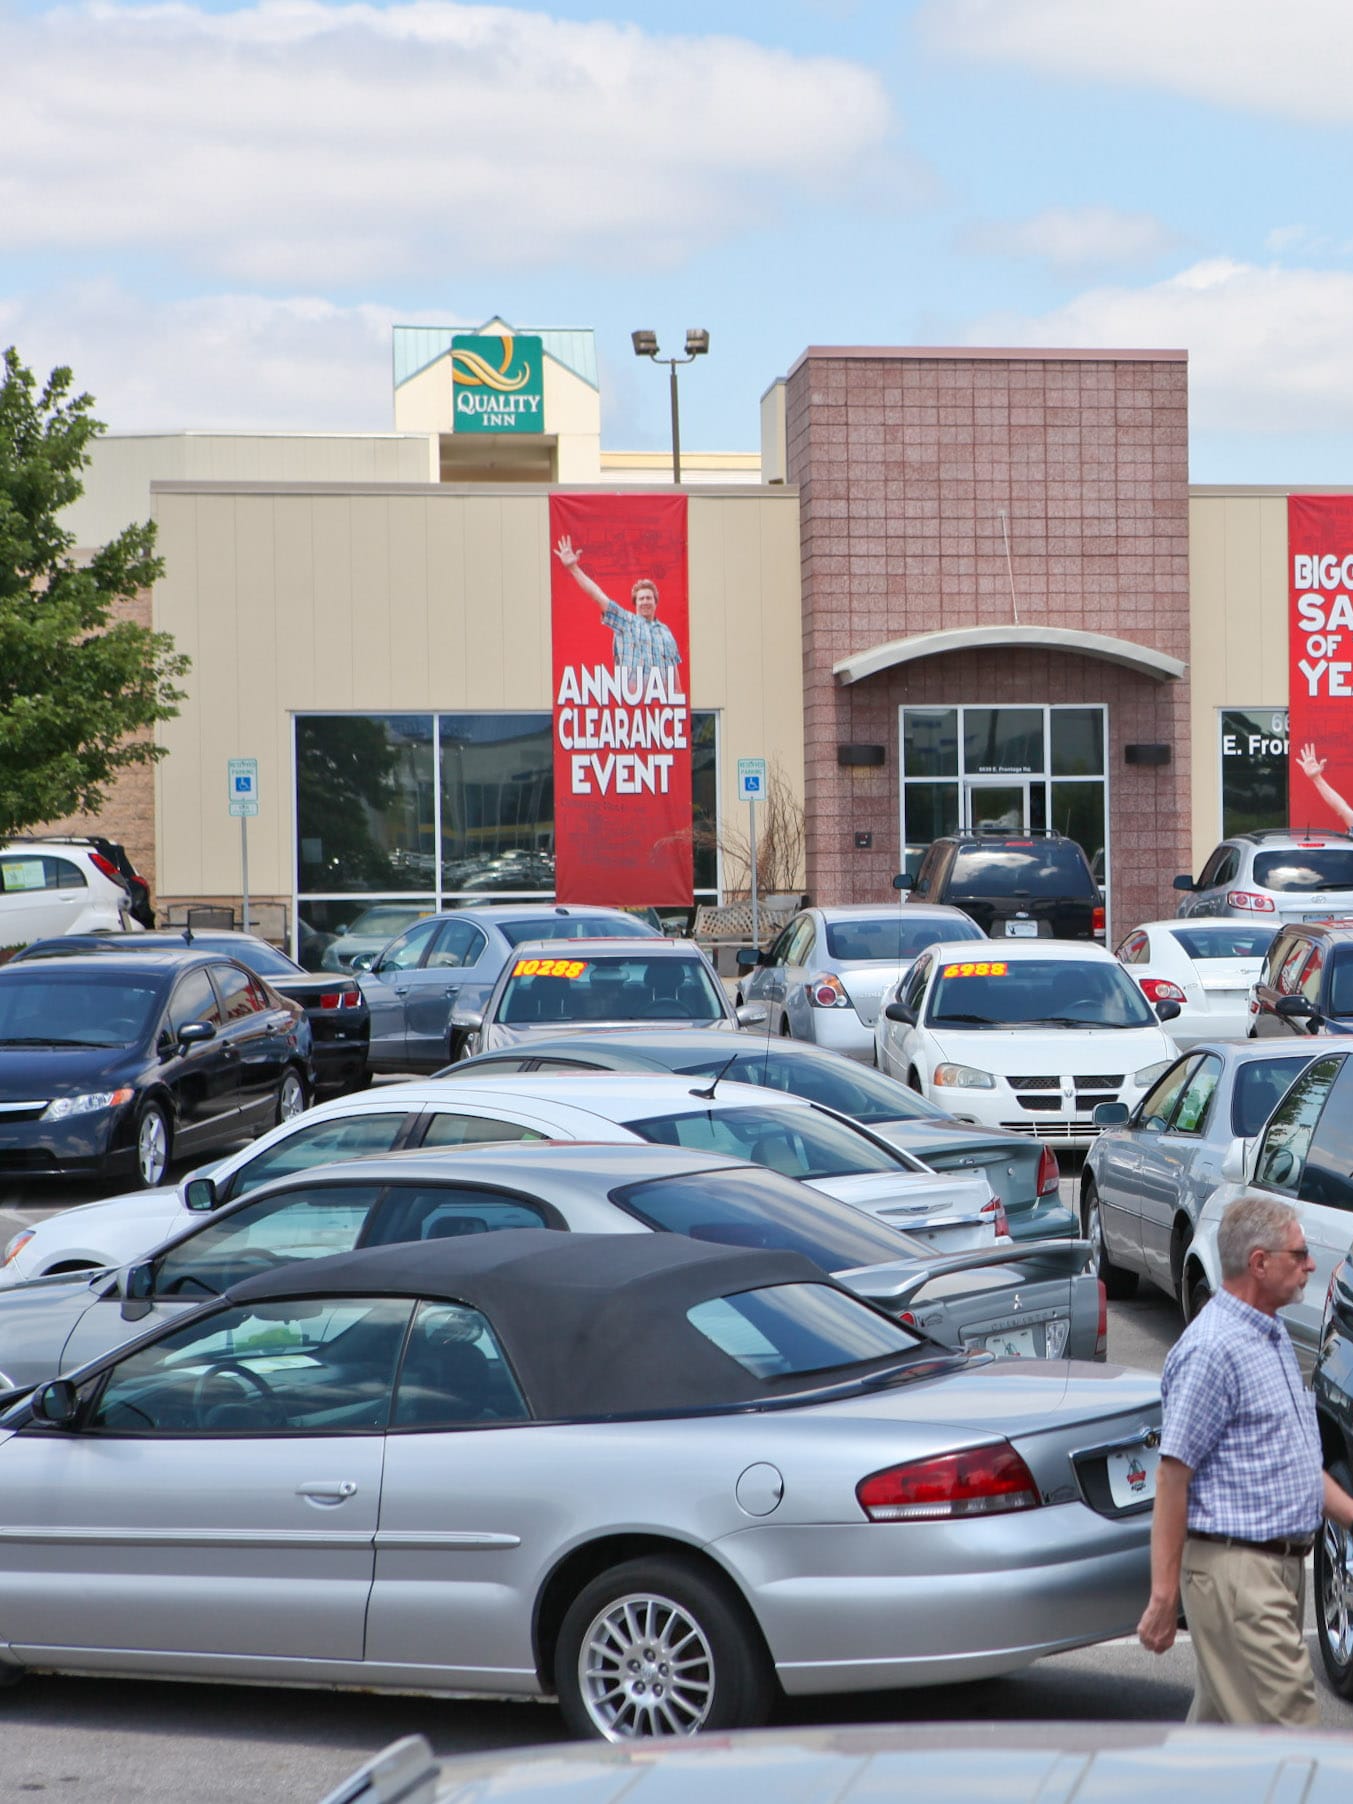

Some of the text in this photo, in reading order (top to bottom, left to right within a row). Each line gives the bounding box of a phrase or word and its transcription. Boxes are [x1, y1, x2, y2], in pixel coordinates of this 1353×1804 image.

[457, 391, 541, 415] QUALITY
[482, 414, 516, 426] INN
[1306, 634, 1342, 658] OF
[557, 664, 686, 706] ANNUAL
[558, 707, 687, 750] CLEARANCE
[1223, 735, 1242, 755] E.
[571, 753, 674, 796] EVENT
[513, 960, 585, 978] 10288
